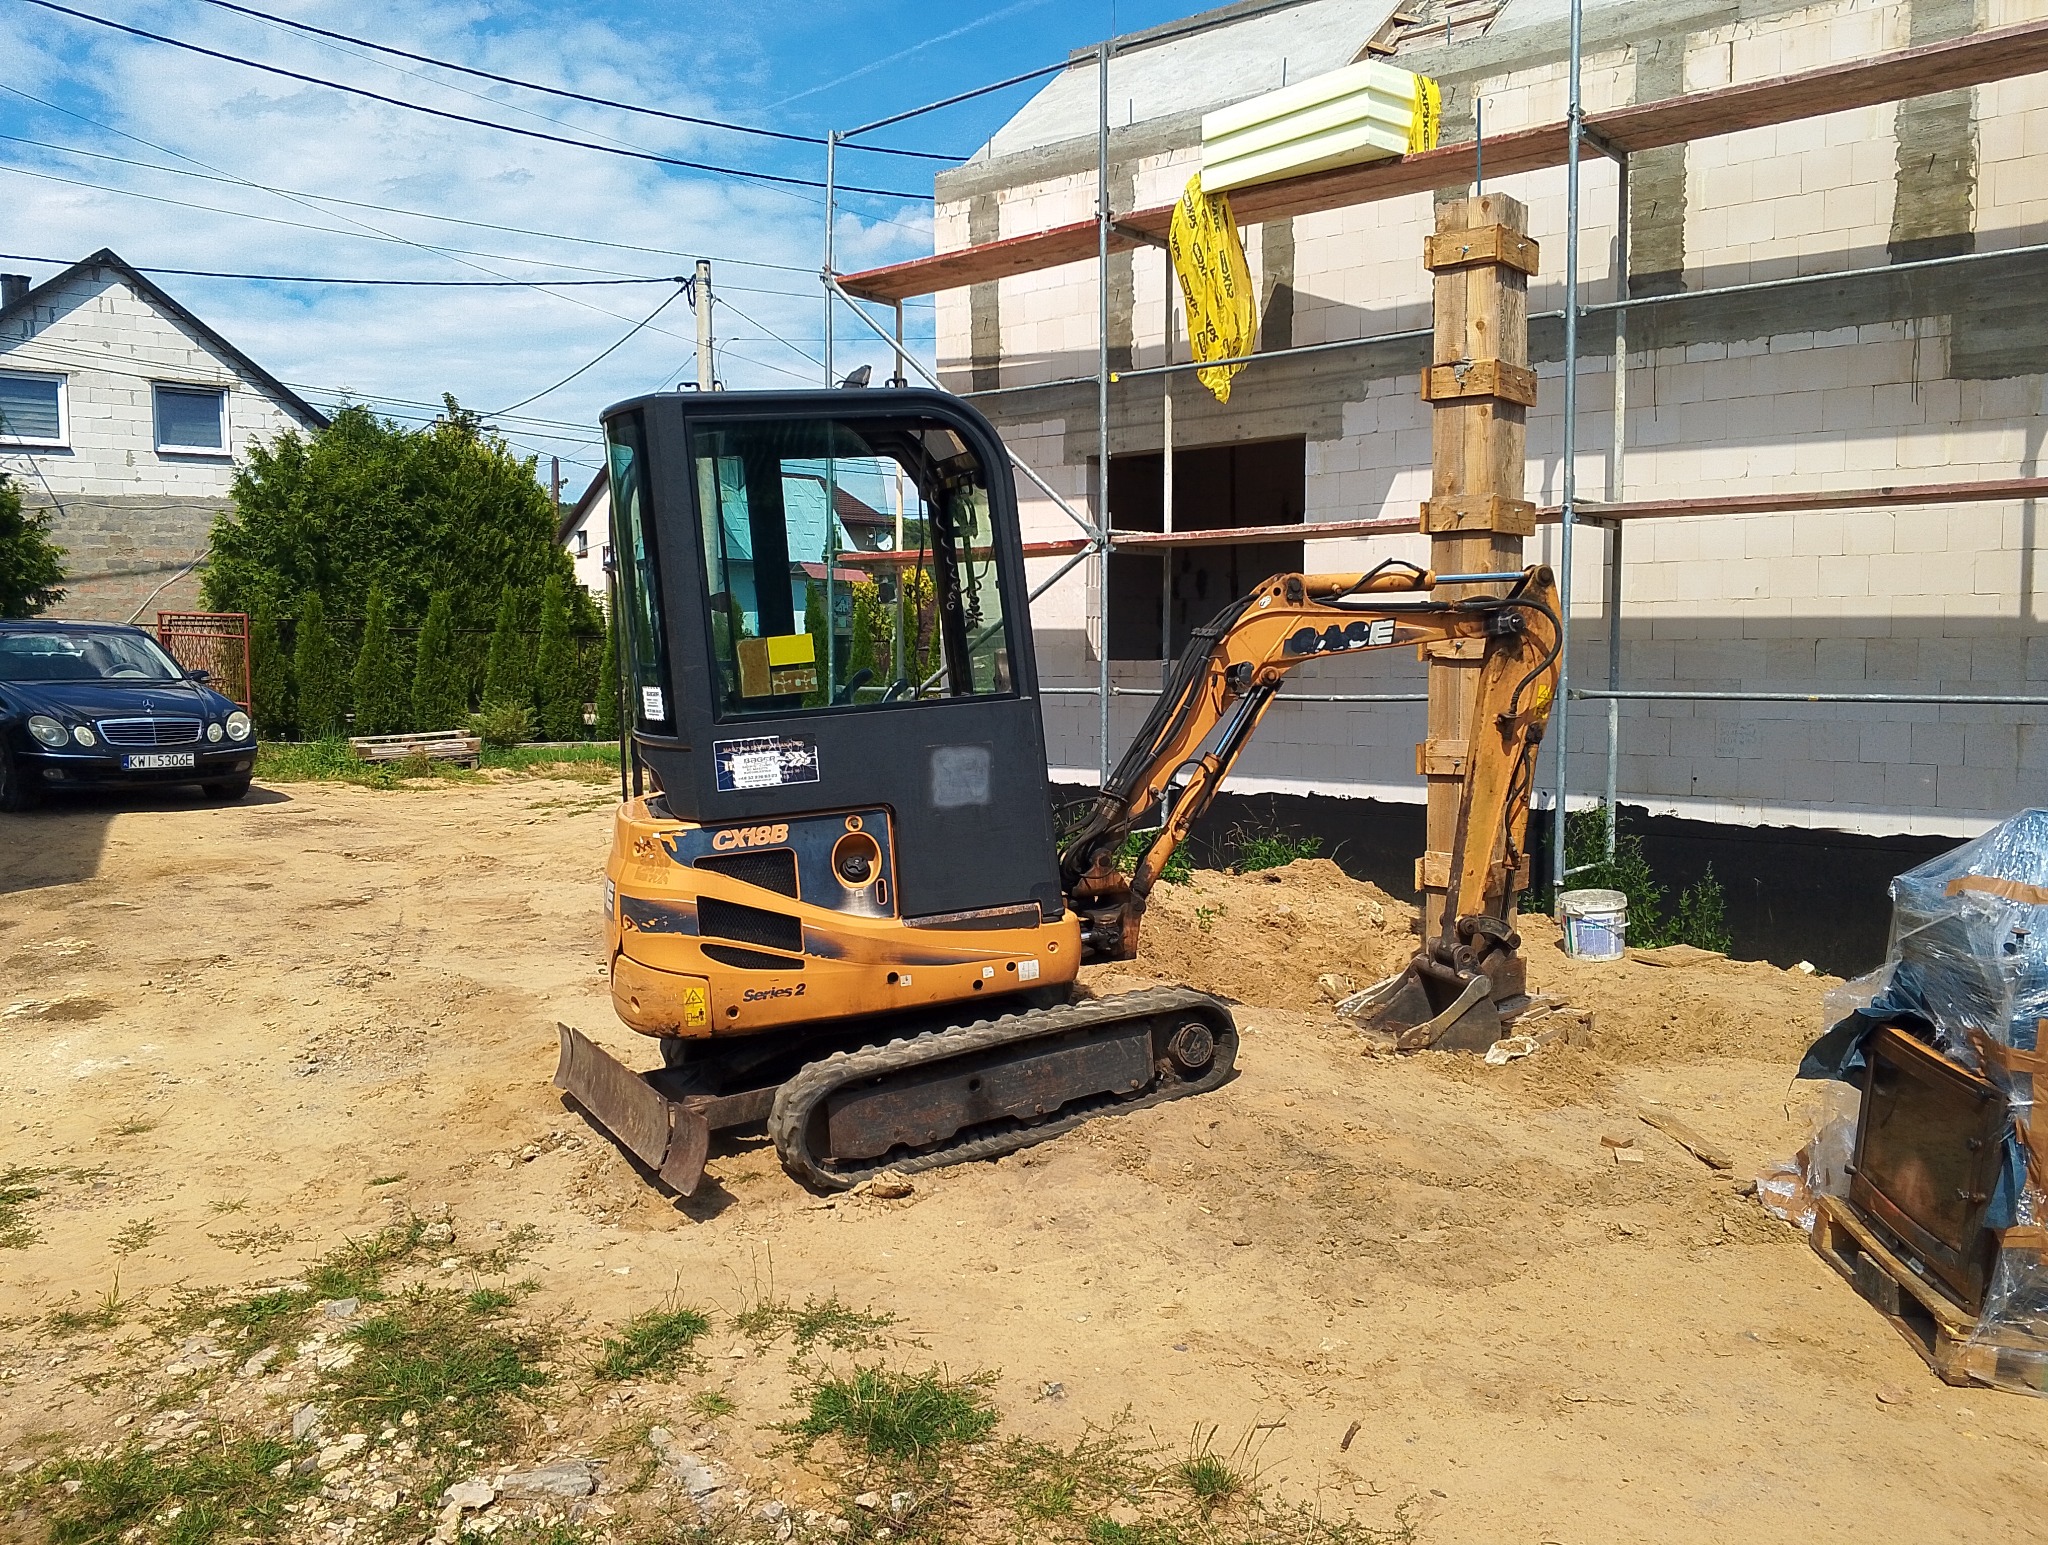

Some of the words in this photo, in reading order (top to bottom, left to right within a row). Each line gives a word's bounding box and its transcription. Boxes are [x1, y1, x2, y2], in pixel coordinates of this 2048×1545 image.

[129, 755, 151, 768] KWI
[157, 753, 193, 767] 5306E
[712, 823, 789, 851] CX18B
[742, 986, 793, 1002] Series
[794, 982, 806, 996] 2
